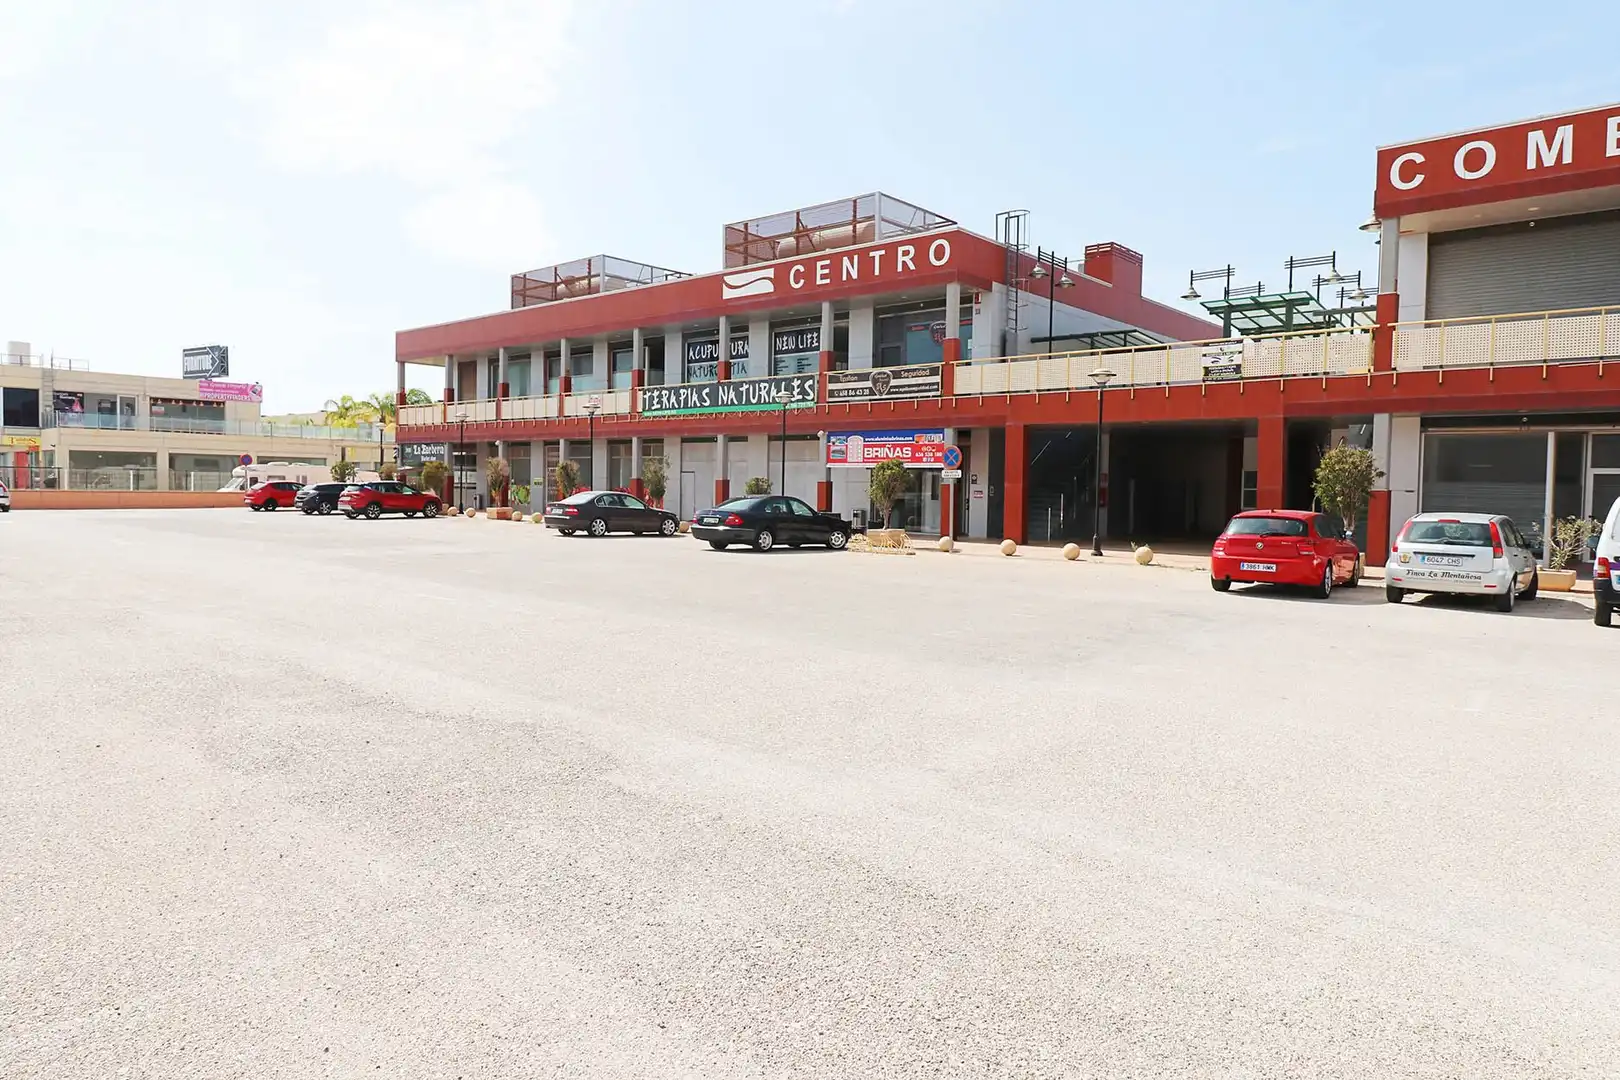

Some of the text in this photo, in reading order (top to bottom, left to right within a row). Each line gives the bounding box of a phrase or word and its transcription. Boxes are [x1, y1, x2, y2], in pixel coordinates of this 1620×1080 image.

[788, 238, 951, 290] CENTRO
[776, 331, 819, 351] NEW LIFE
[643, 387, 710, 410] TERAPIAS
[864, 444, 911, 458] BRIÑAS
[1426, 556, 1461, 565] 6047 CHS
[1406, 569, 1426, 577] Finca
[1427, 570, 1438, 578] La
